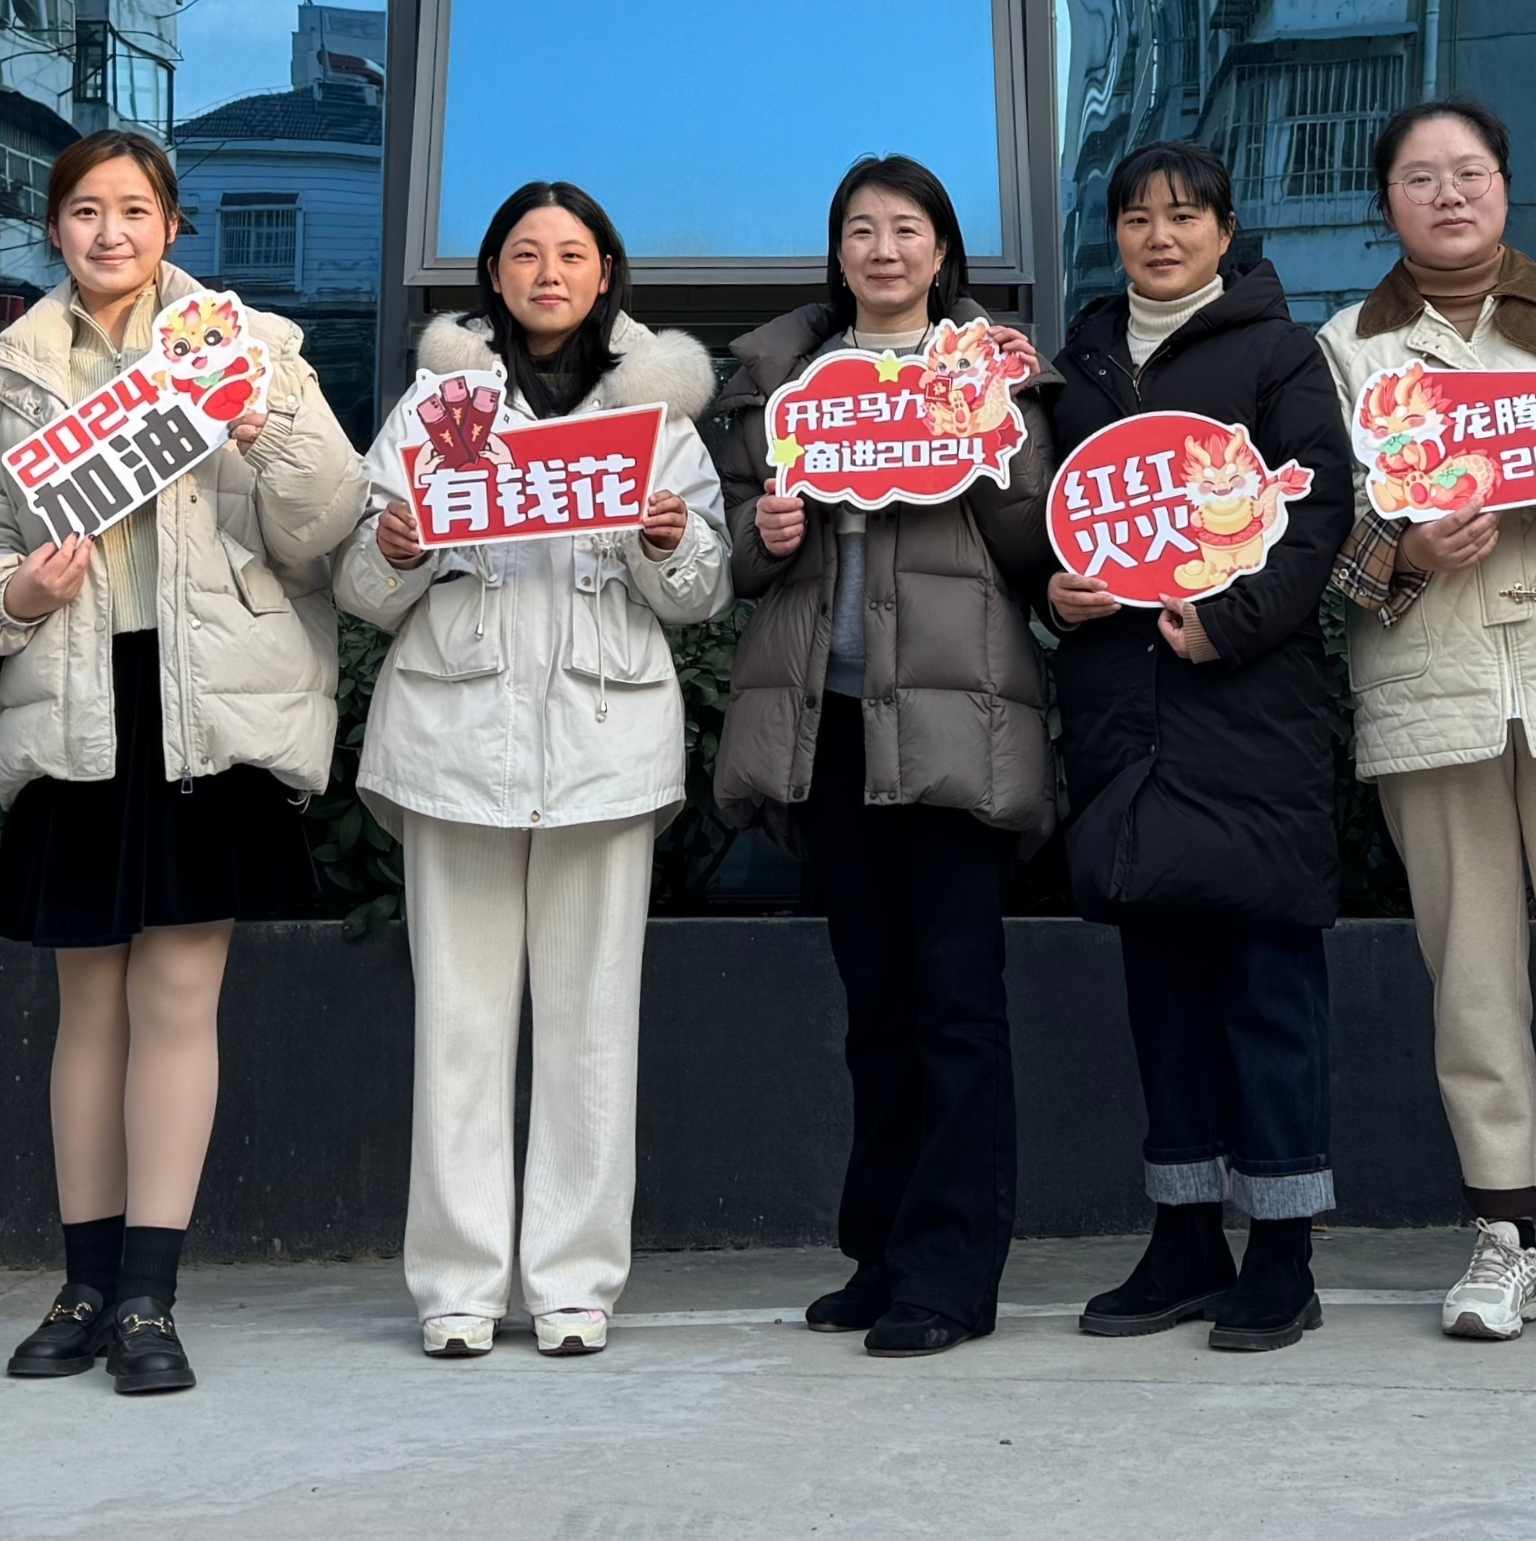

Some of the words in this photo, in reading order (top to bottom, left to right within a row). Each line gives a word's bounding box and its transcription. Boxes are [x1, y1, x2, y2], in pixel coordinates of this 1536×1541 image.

[7, 369, 162, 488] 2024
[784, 389, 927, 433] 开足马力
[32, 407, 209, 539] 加油
[802, 434, 986, 474] 奋进2024
[1063, 449, 1188, 522] 红红
[421, 453, 640, 535] 有钱花
[1073, 504, 1200, 579] 火火
